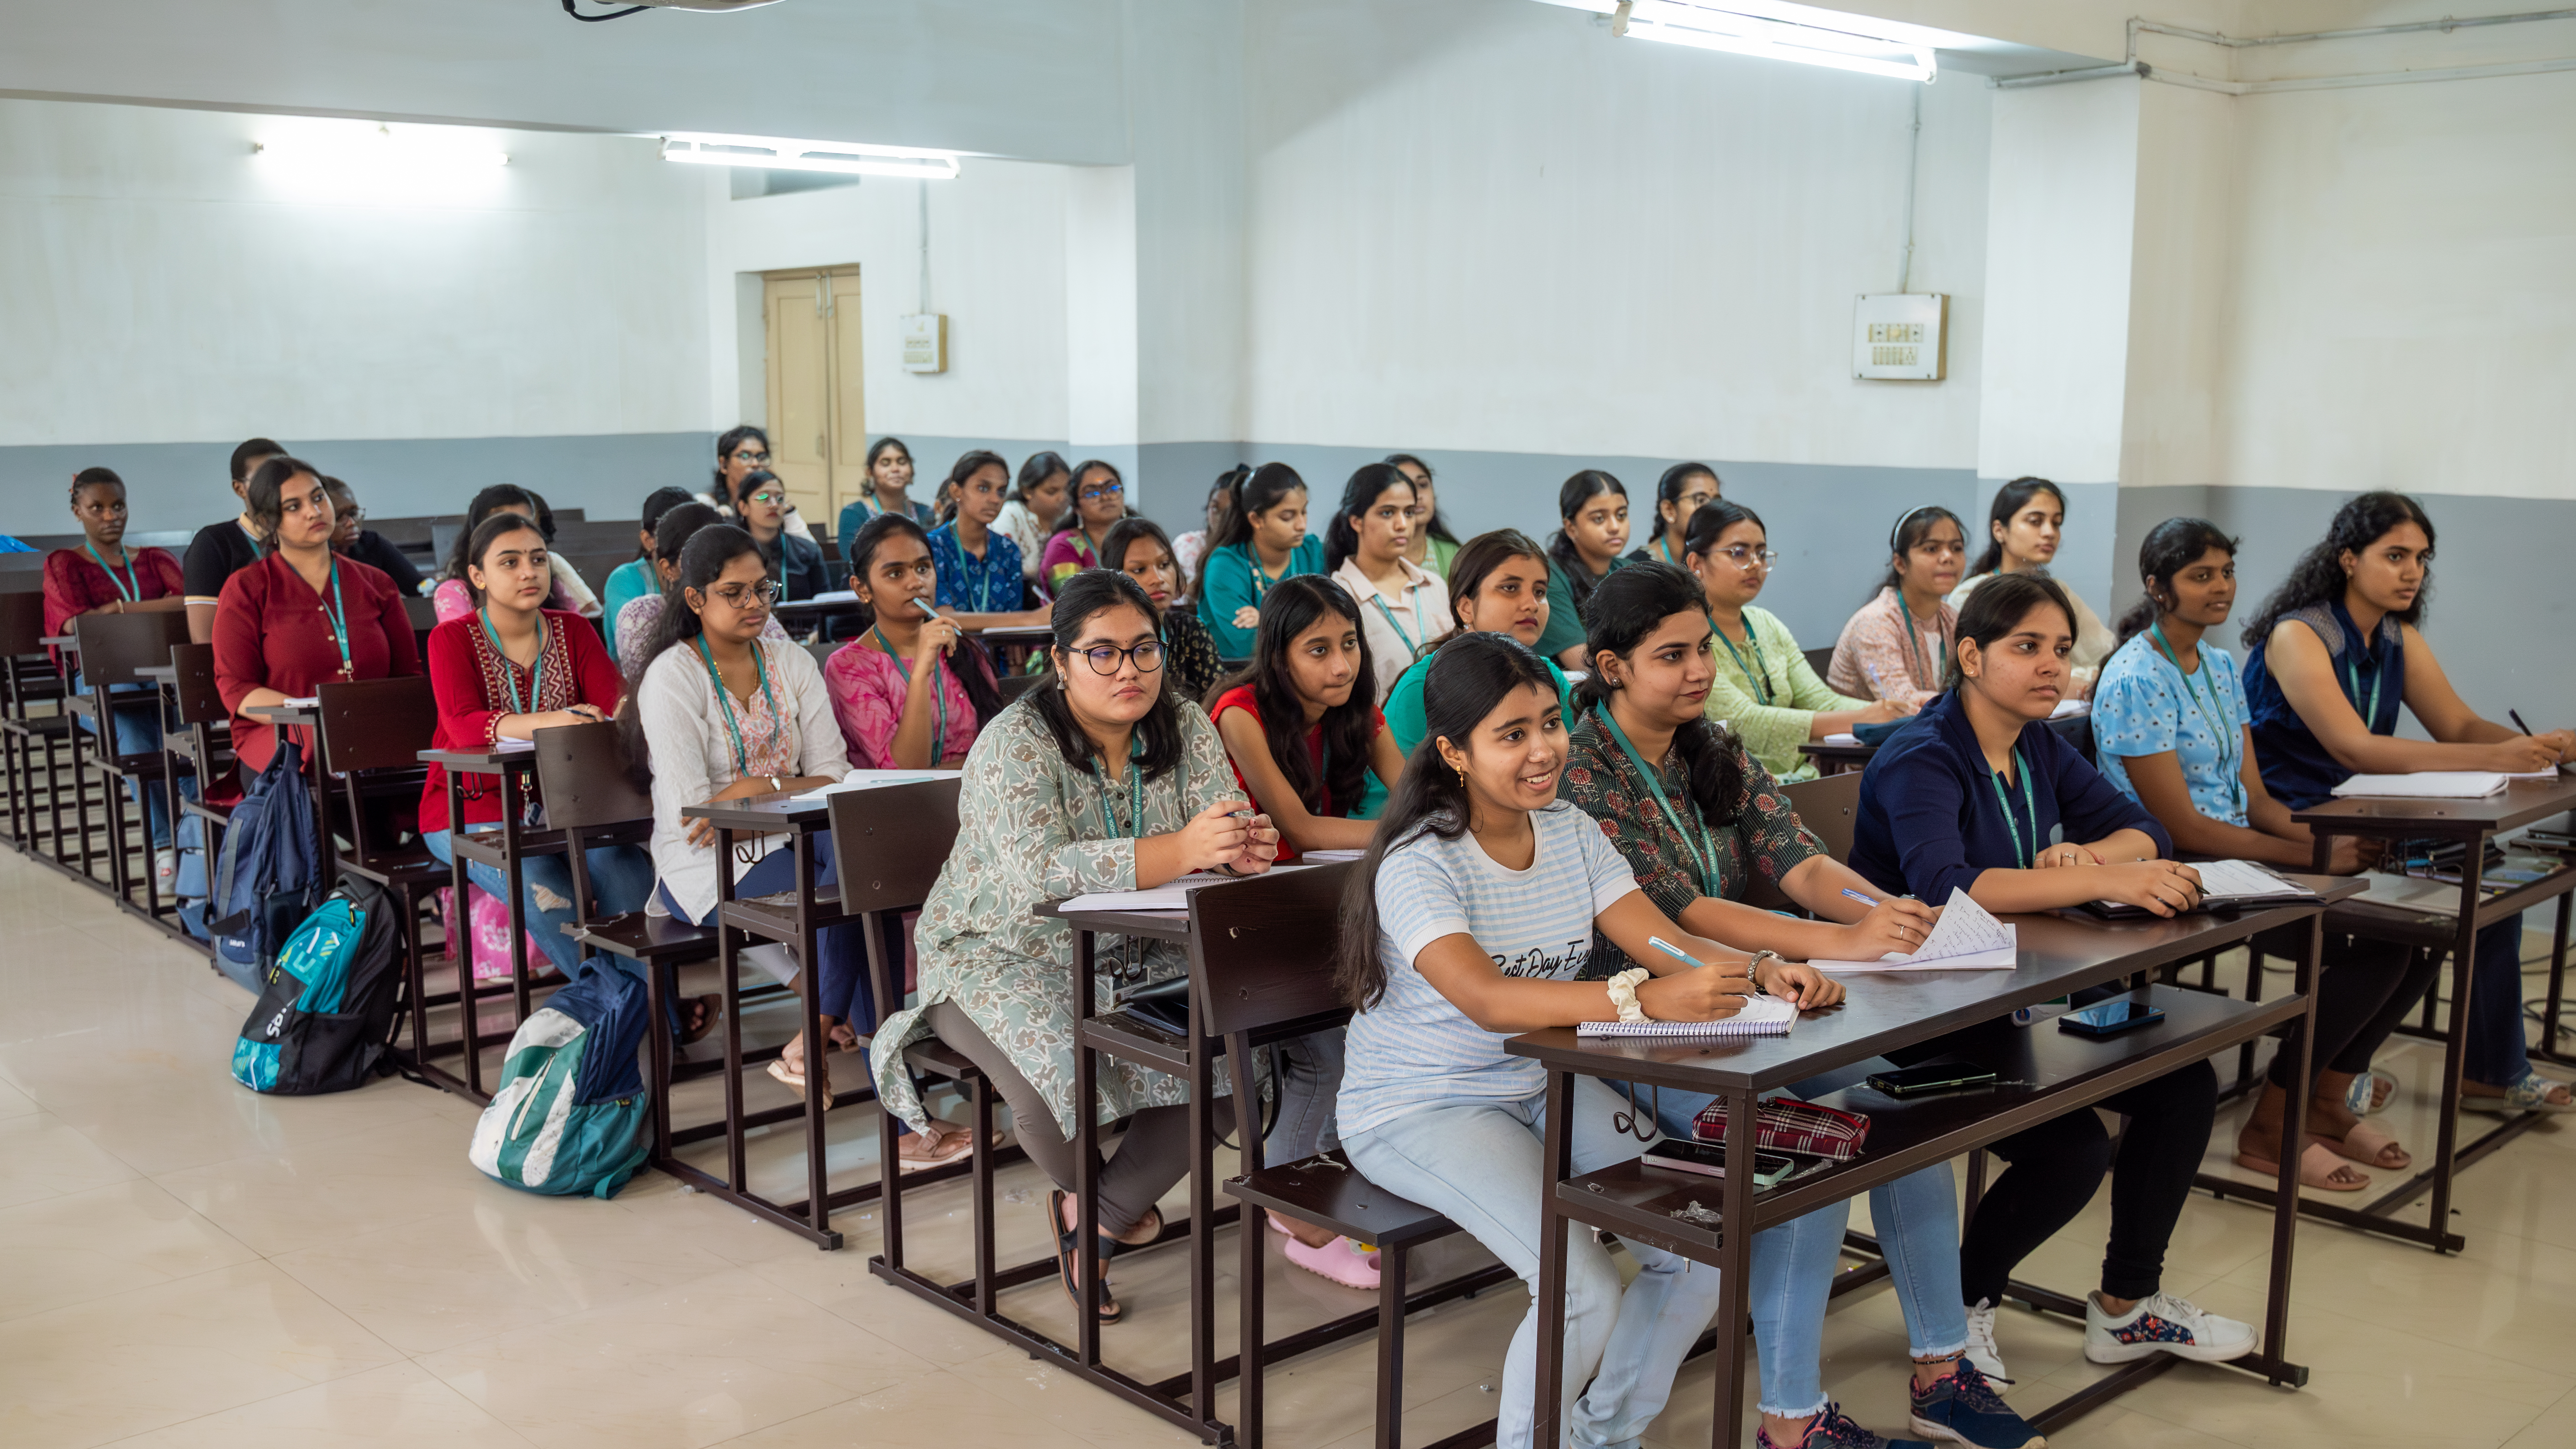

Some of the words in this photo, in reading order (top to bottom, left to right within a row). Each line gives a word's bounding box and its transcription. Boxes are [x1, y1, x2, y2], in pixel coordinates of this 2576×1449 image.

[1659, 797, 1680, 826] PHARMACY
[1108, 818, 1117, 838] CHOOL
[1684, 834, 1698, 857] SCHOOL
[1703, 831, 1713, 854] SCHOOL
[1526, 948, 1562, 979] Day
